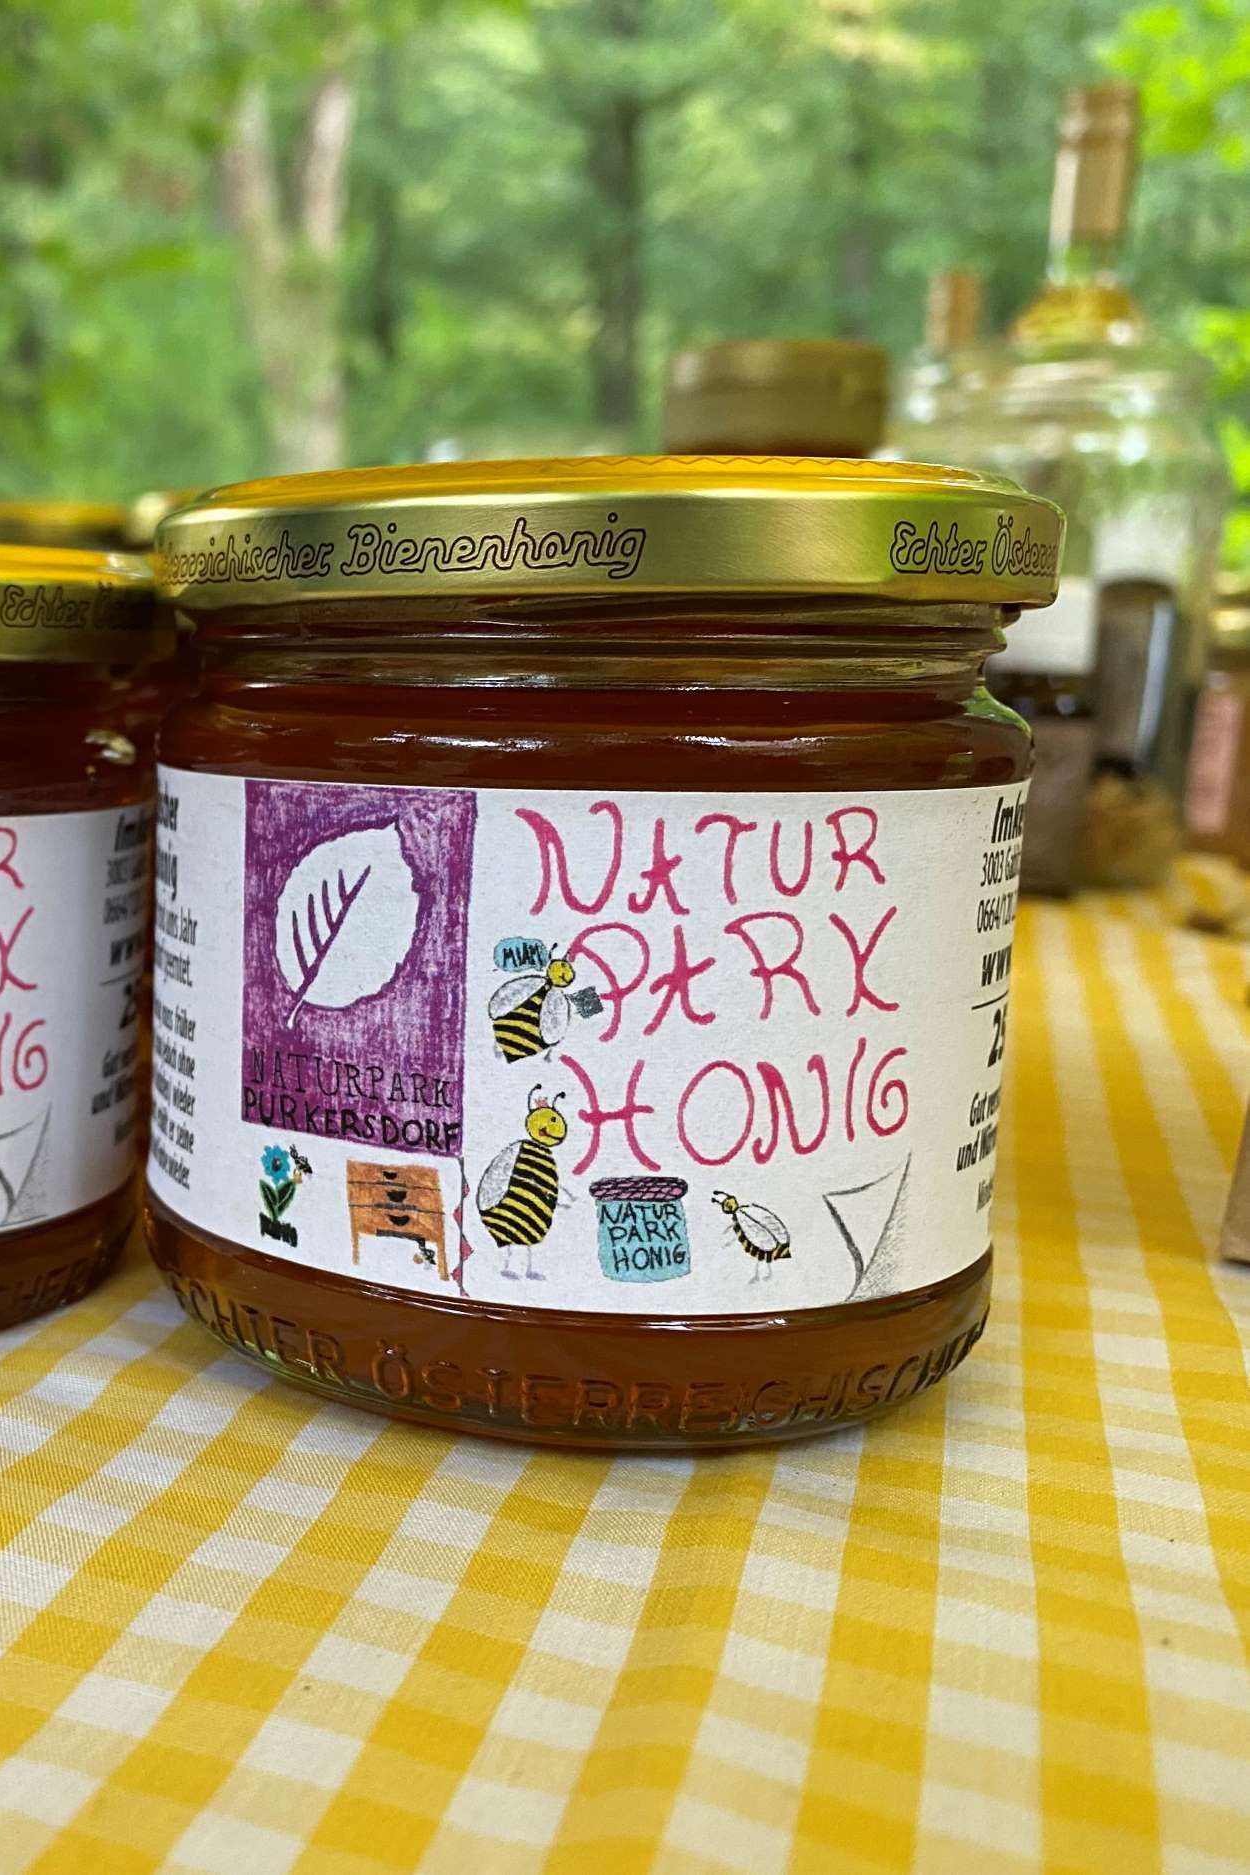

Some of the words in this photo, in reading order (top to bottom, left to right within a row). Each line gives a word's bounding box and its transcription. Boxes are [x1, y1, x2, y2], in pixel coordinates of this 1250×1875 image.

[341, 512, 647, 579] Bienenhonig
[890, 520, 987, 575] Echter
[0, 584, 91, 629] Echter
[515, 801, 885, 915] NATUR
[980, 849, 1005, 887] 3003
[568, 907, 899, 1041] PARK
[251, 1047, 453, 1108] NATURPARK
[243, 1086, 461, 1151] PURKERSDORF
[560, 1038, 908, 1175] HONIG
[969, 1091, 987, 1128] Gut
[956, 1130, 980, 1173] und
[600, 1202, 682, 1224] NATUR
[607, 1221, 681, 1246] PARK
[612, 1243, 686, 1273] HONIG
